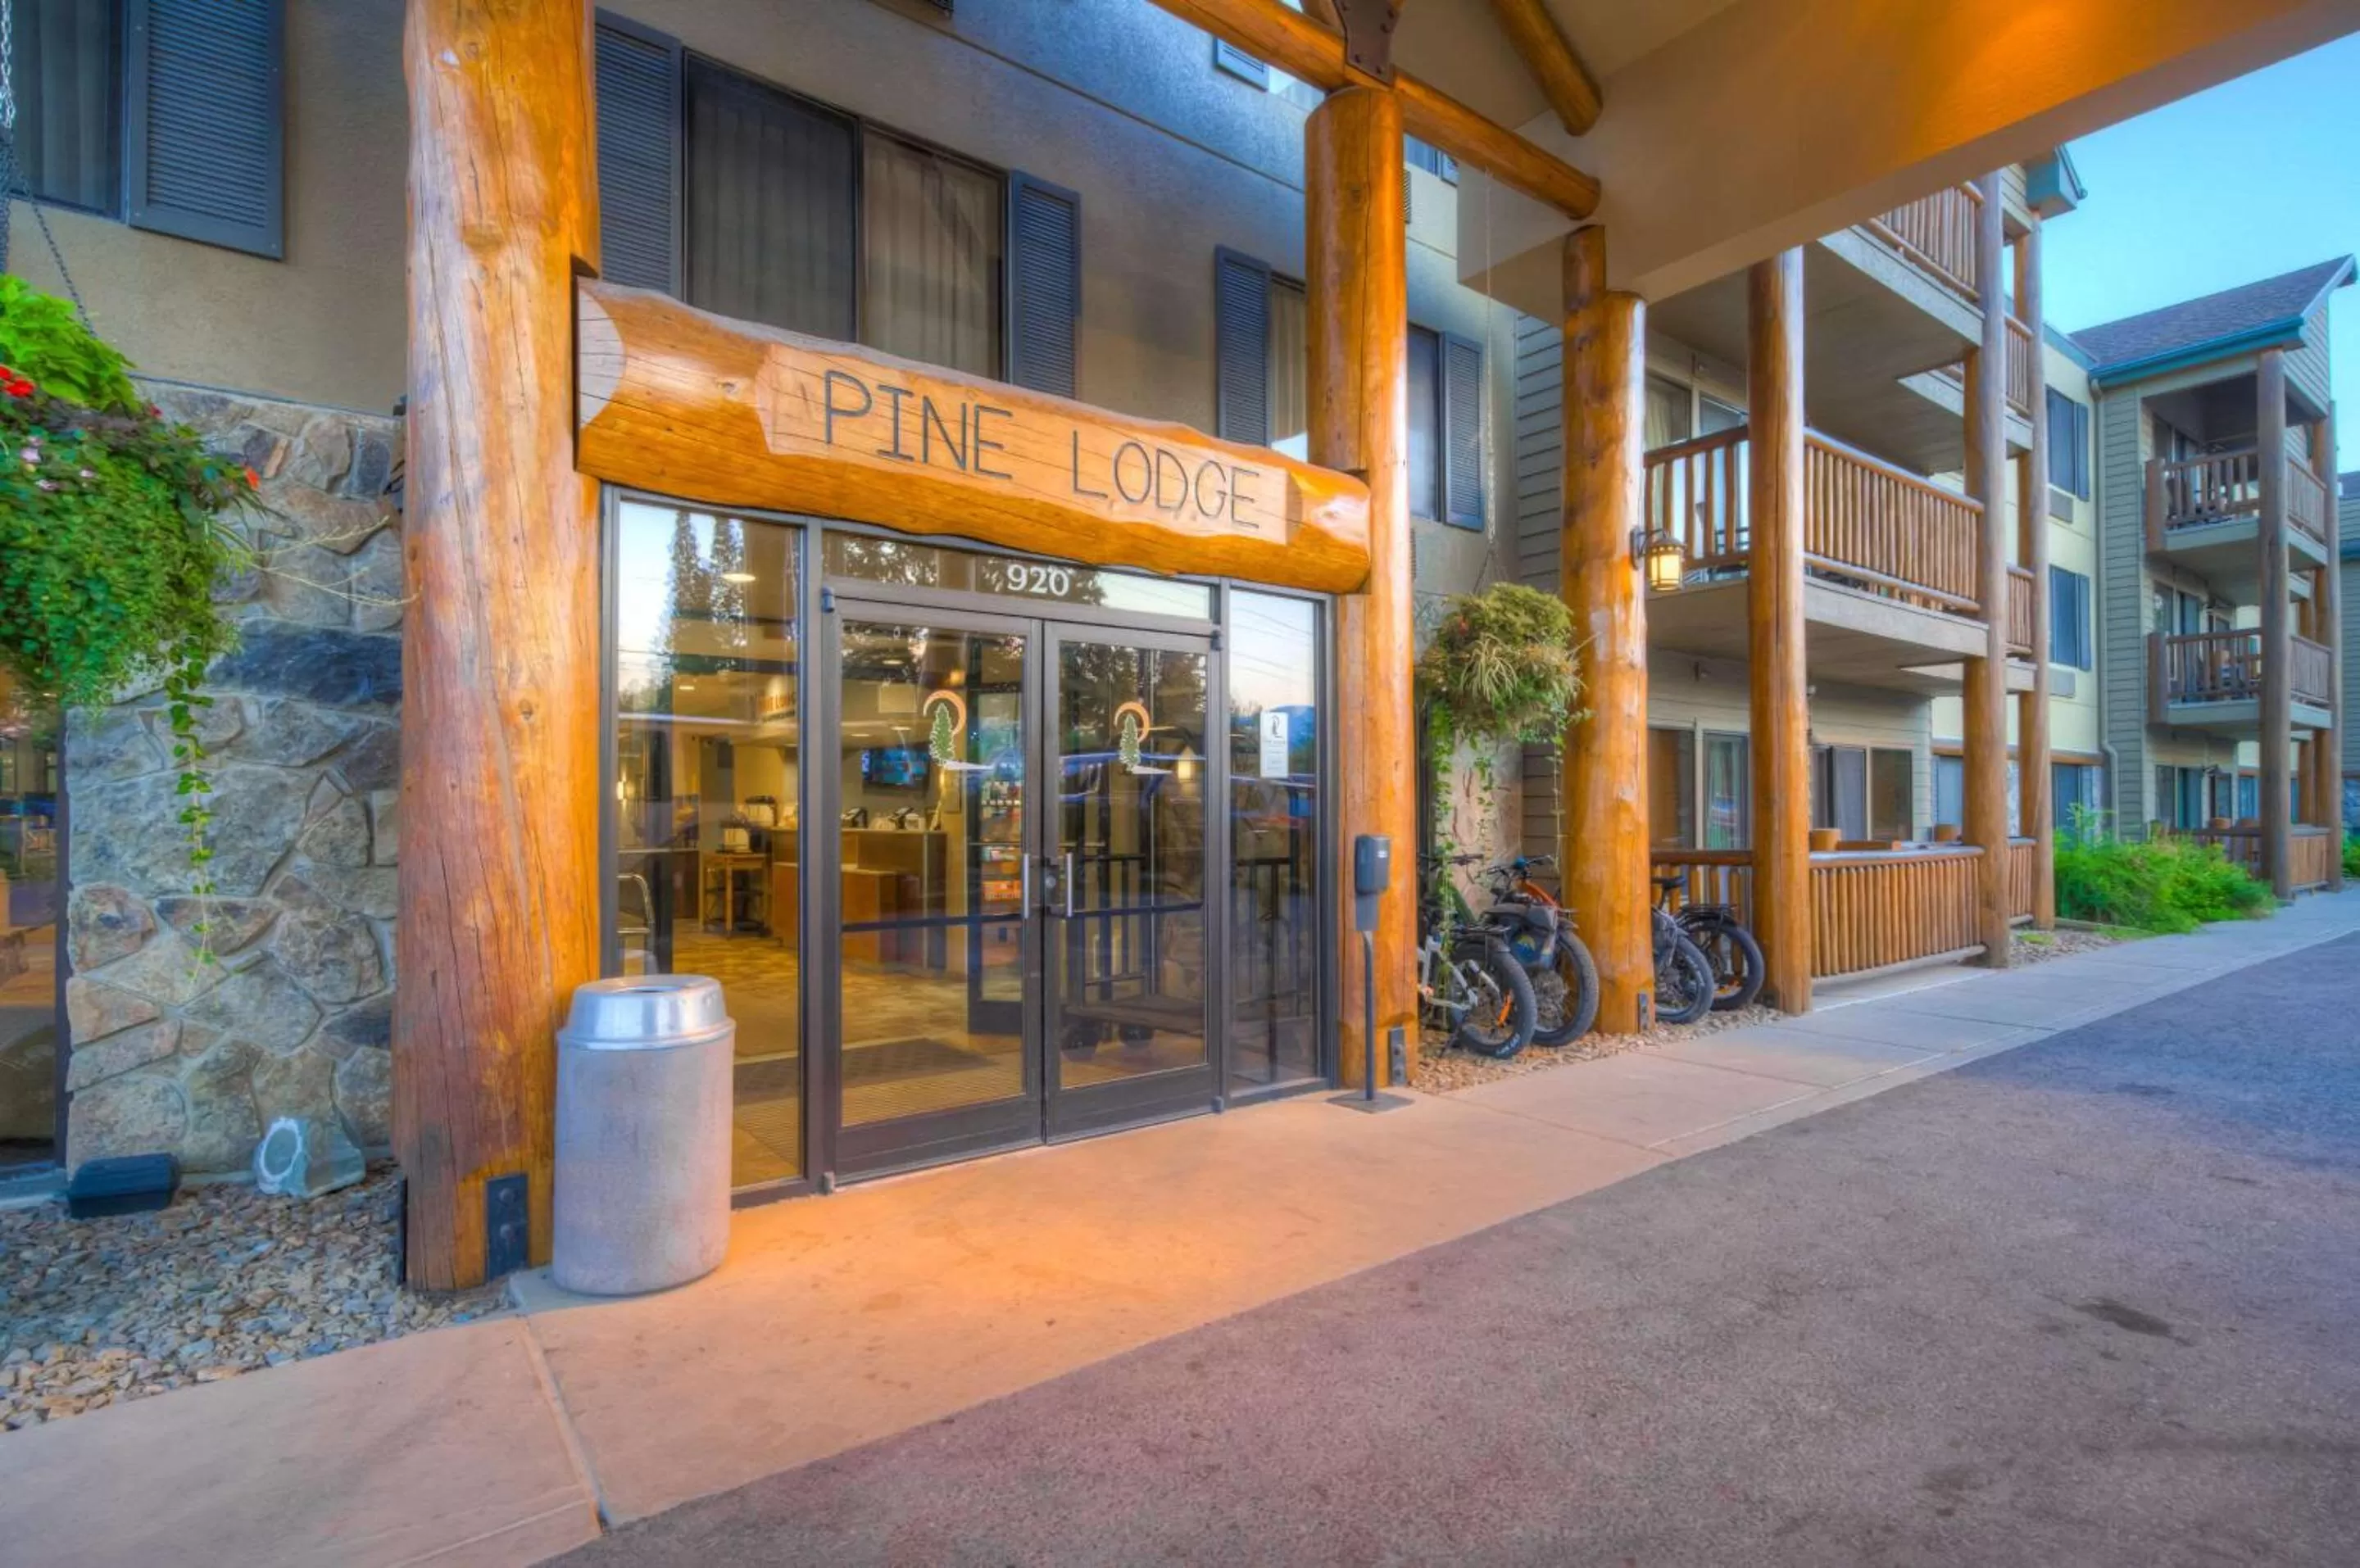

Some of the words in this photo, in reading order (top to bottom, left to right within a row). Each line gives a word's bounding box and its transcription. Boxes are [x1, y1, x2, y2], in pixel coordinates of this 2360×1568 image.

[824, 369, 1013, 479] PINE
[1073, 430, 1259, 528] LODGE
[1007, 564, 1069, 596] 920
